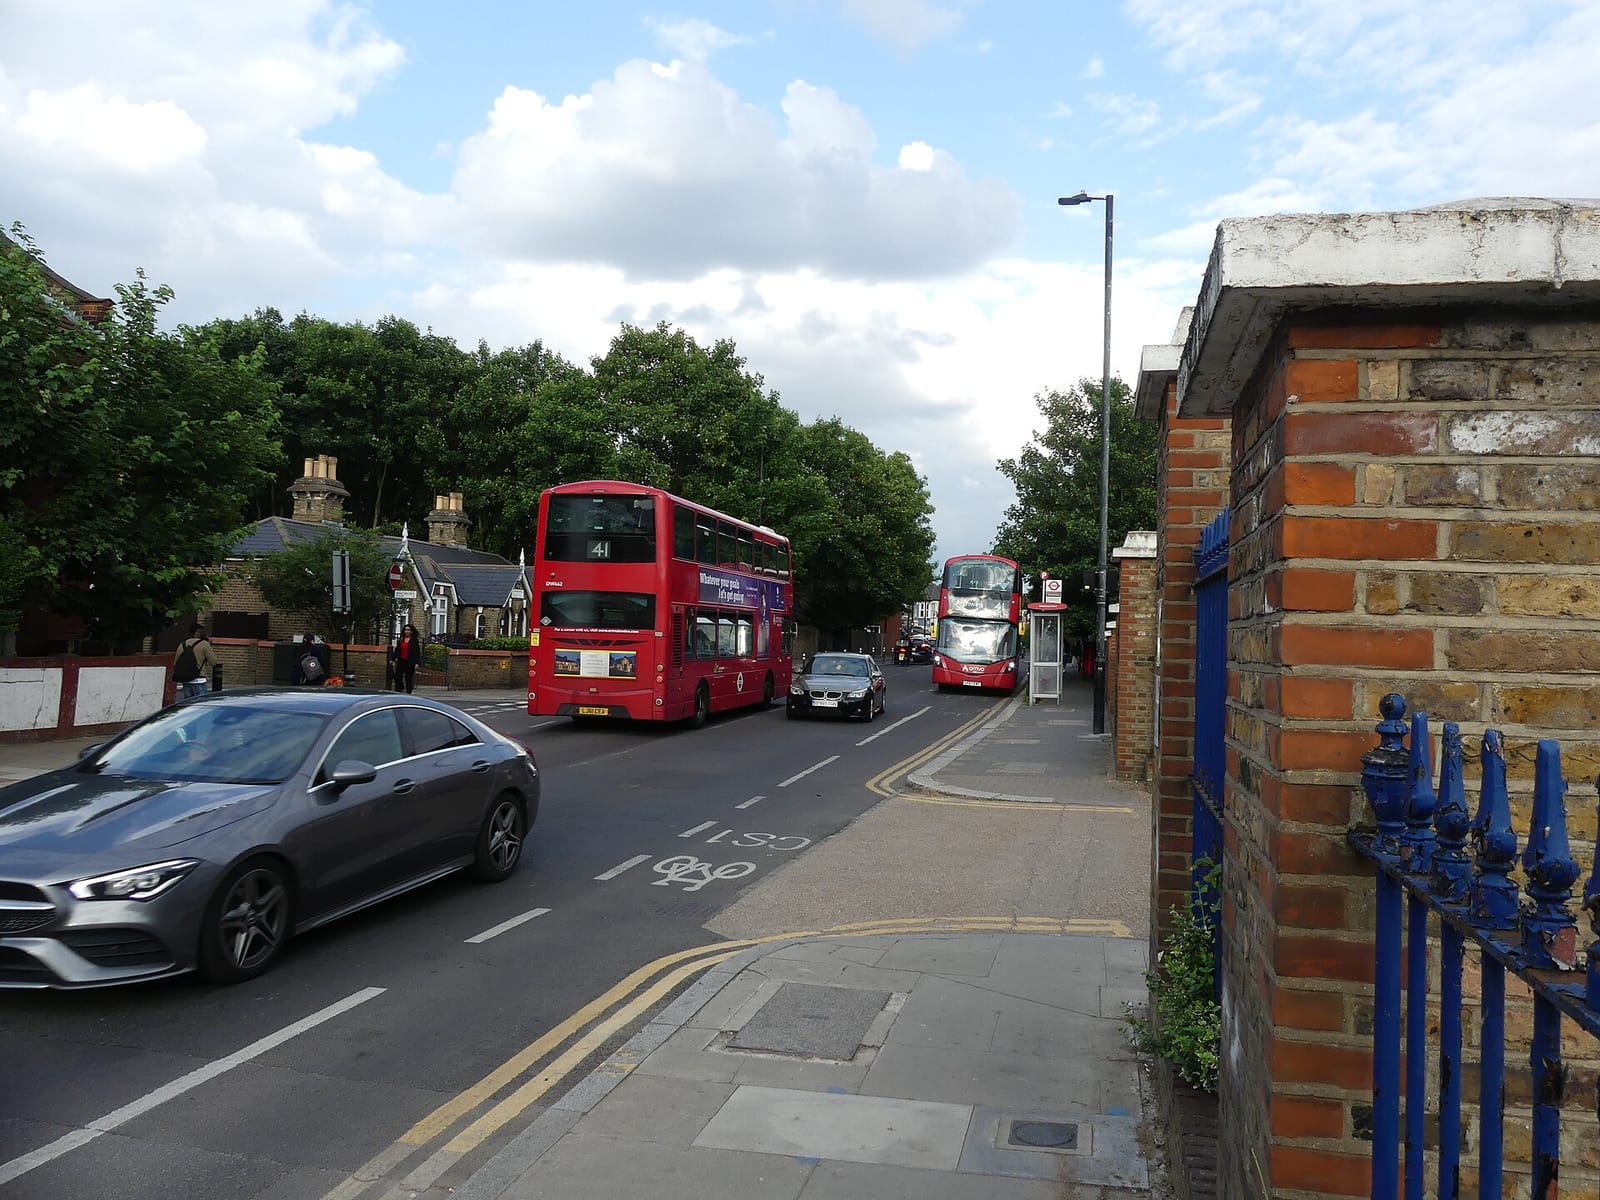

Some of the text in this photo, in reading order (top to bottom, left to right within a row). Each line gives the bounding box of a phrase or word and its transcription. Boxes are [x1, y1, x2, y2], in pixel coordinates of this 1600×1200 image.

[592, 541, 609, 557] 41
[699, 572, 720, 587] Whatever
[721, 578, 729, 589] your
[730, 579, 740, 591] goals
[734, 590, 744, 604] going
[705, 829, 812, 851] CS1
